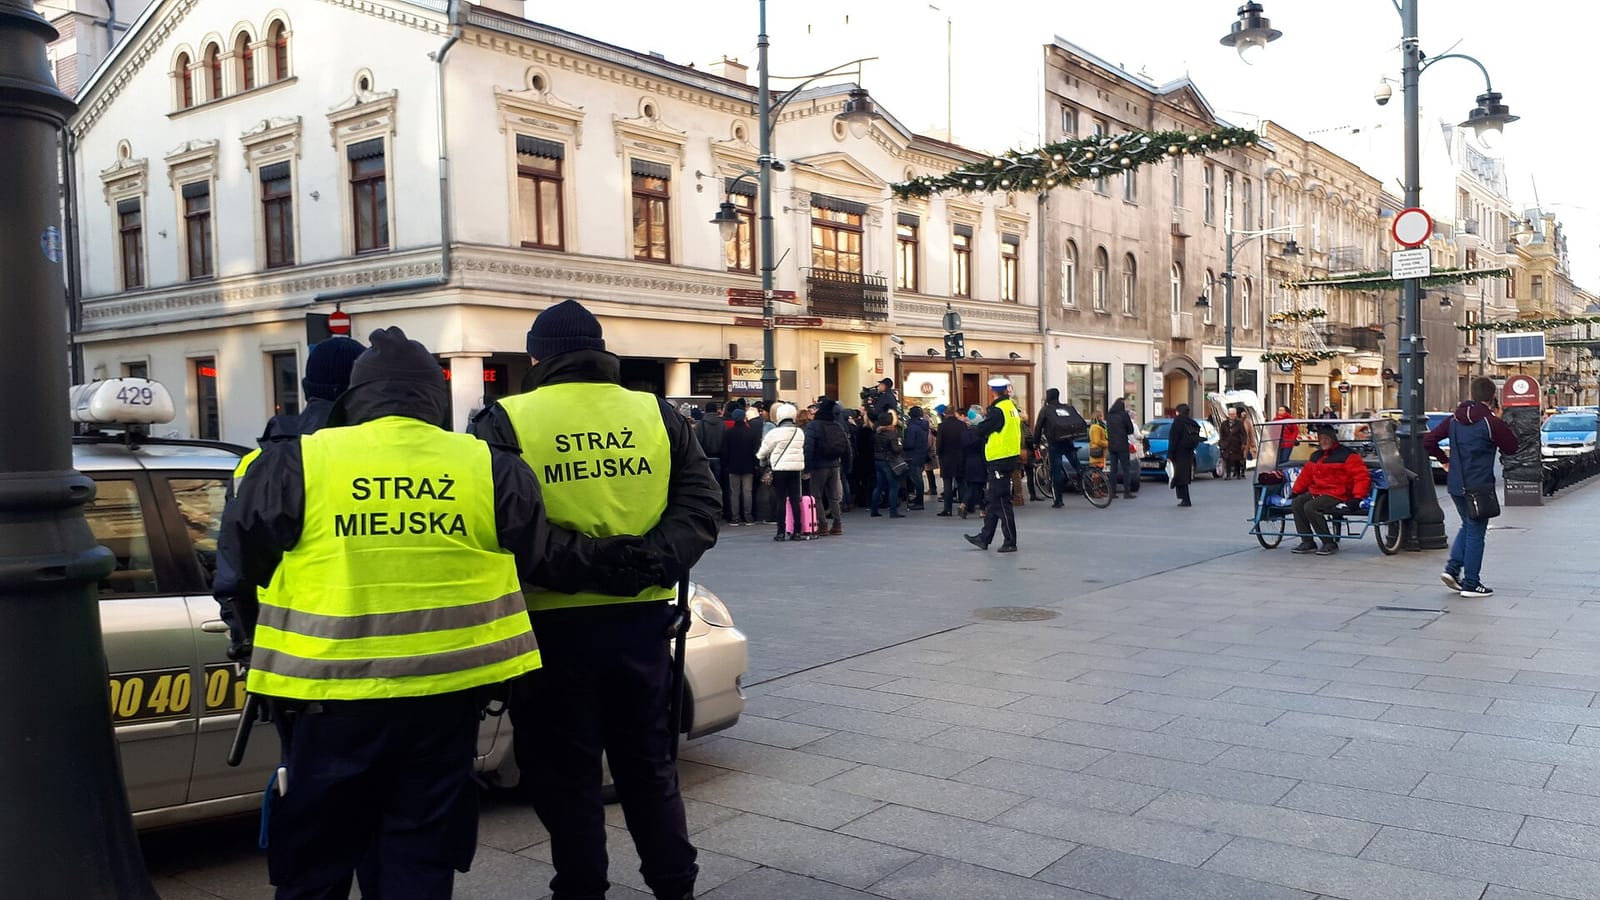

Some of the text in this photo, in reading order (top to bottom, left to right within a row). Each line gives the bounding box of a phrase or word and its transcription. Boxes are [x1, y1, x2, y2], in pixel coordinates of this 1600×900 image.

[116, 386, 153, 406] 429
[554, 427, 636, 453] STRAŻ
[544, 456, 653, 484] MIEJSKA
[352, 473, 456, 501] STRAŻ
[335, 511, 468, 537] MIEJSKA
